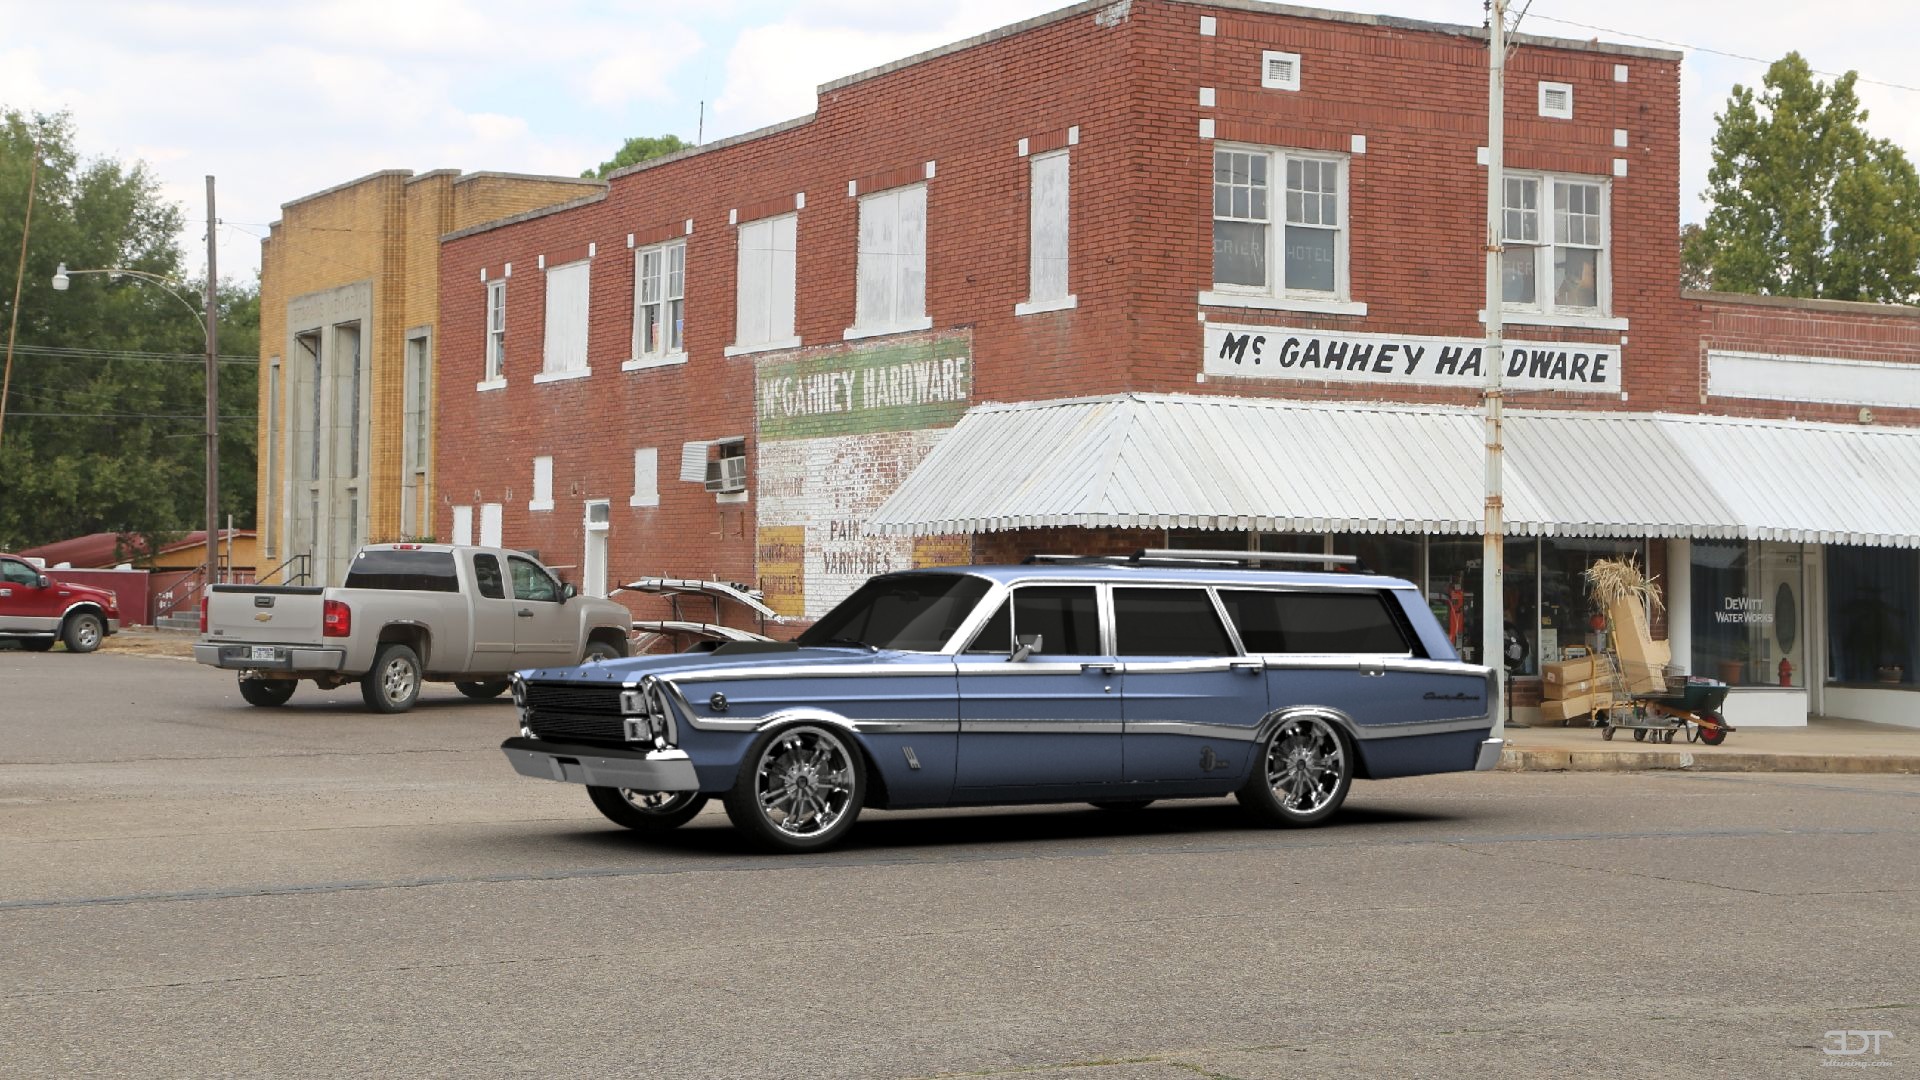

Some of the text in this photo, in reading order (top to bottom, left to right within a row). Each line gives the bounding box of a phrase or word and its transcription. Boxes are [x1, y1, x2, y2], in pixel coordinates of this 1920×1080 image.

[1287, 245, 1331, 262] HOTEL
[1279, 337, 1425, 375] GAHHEY
[1435, 345, 1609, 383] HADWARE
[863, 356, 966, 409] HARDWARE
[830, 518, 867, 541] PAIN
[823, 550, 891, 575] VARNISHES
